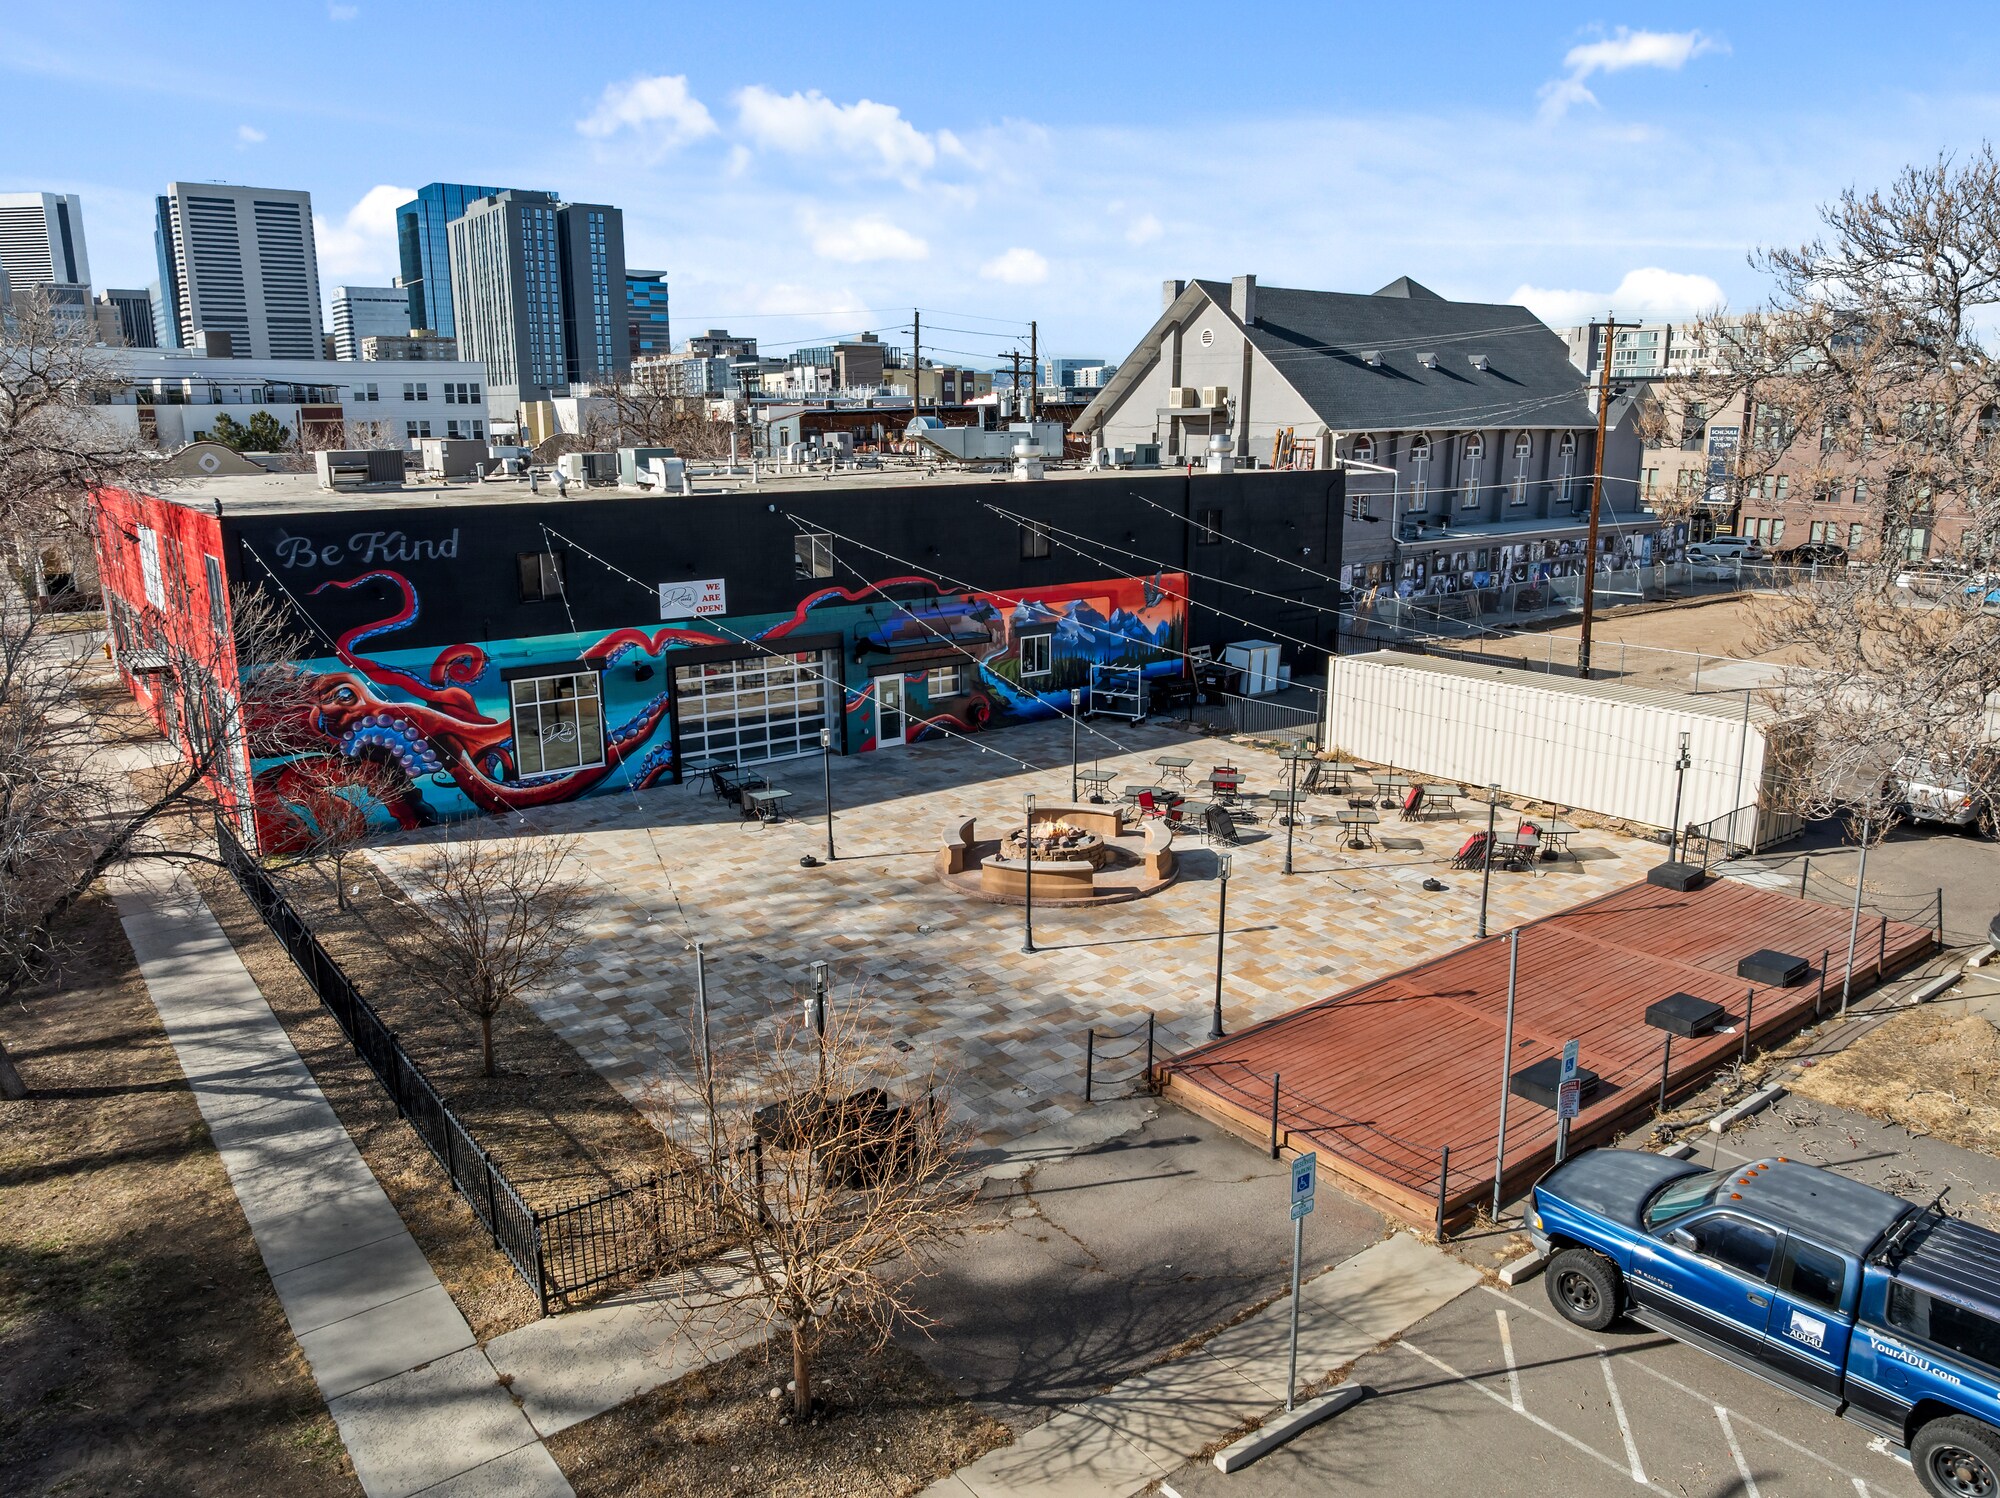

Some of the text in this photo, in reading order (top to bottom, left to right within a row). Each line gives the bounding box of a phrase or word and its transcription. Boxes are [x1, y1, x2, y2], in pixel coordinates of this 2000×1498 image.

[275, 528, 459, 569] Be Kind
[706, 583, 720, 591] WE
[702, 594, 720, 602] ARE
[696, 604, 723, 613] OPEN!
[1790, 1329, 1823, 1348] ADU4U
[1870, 1337, 1961, 1387] YourADU.com
